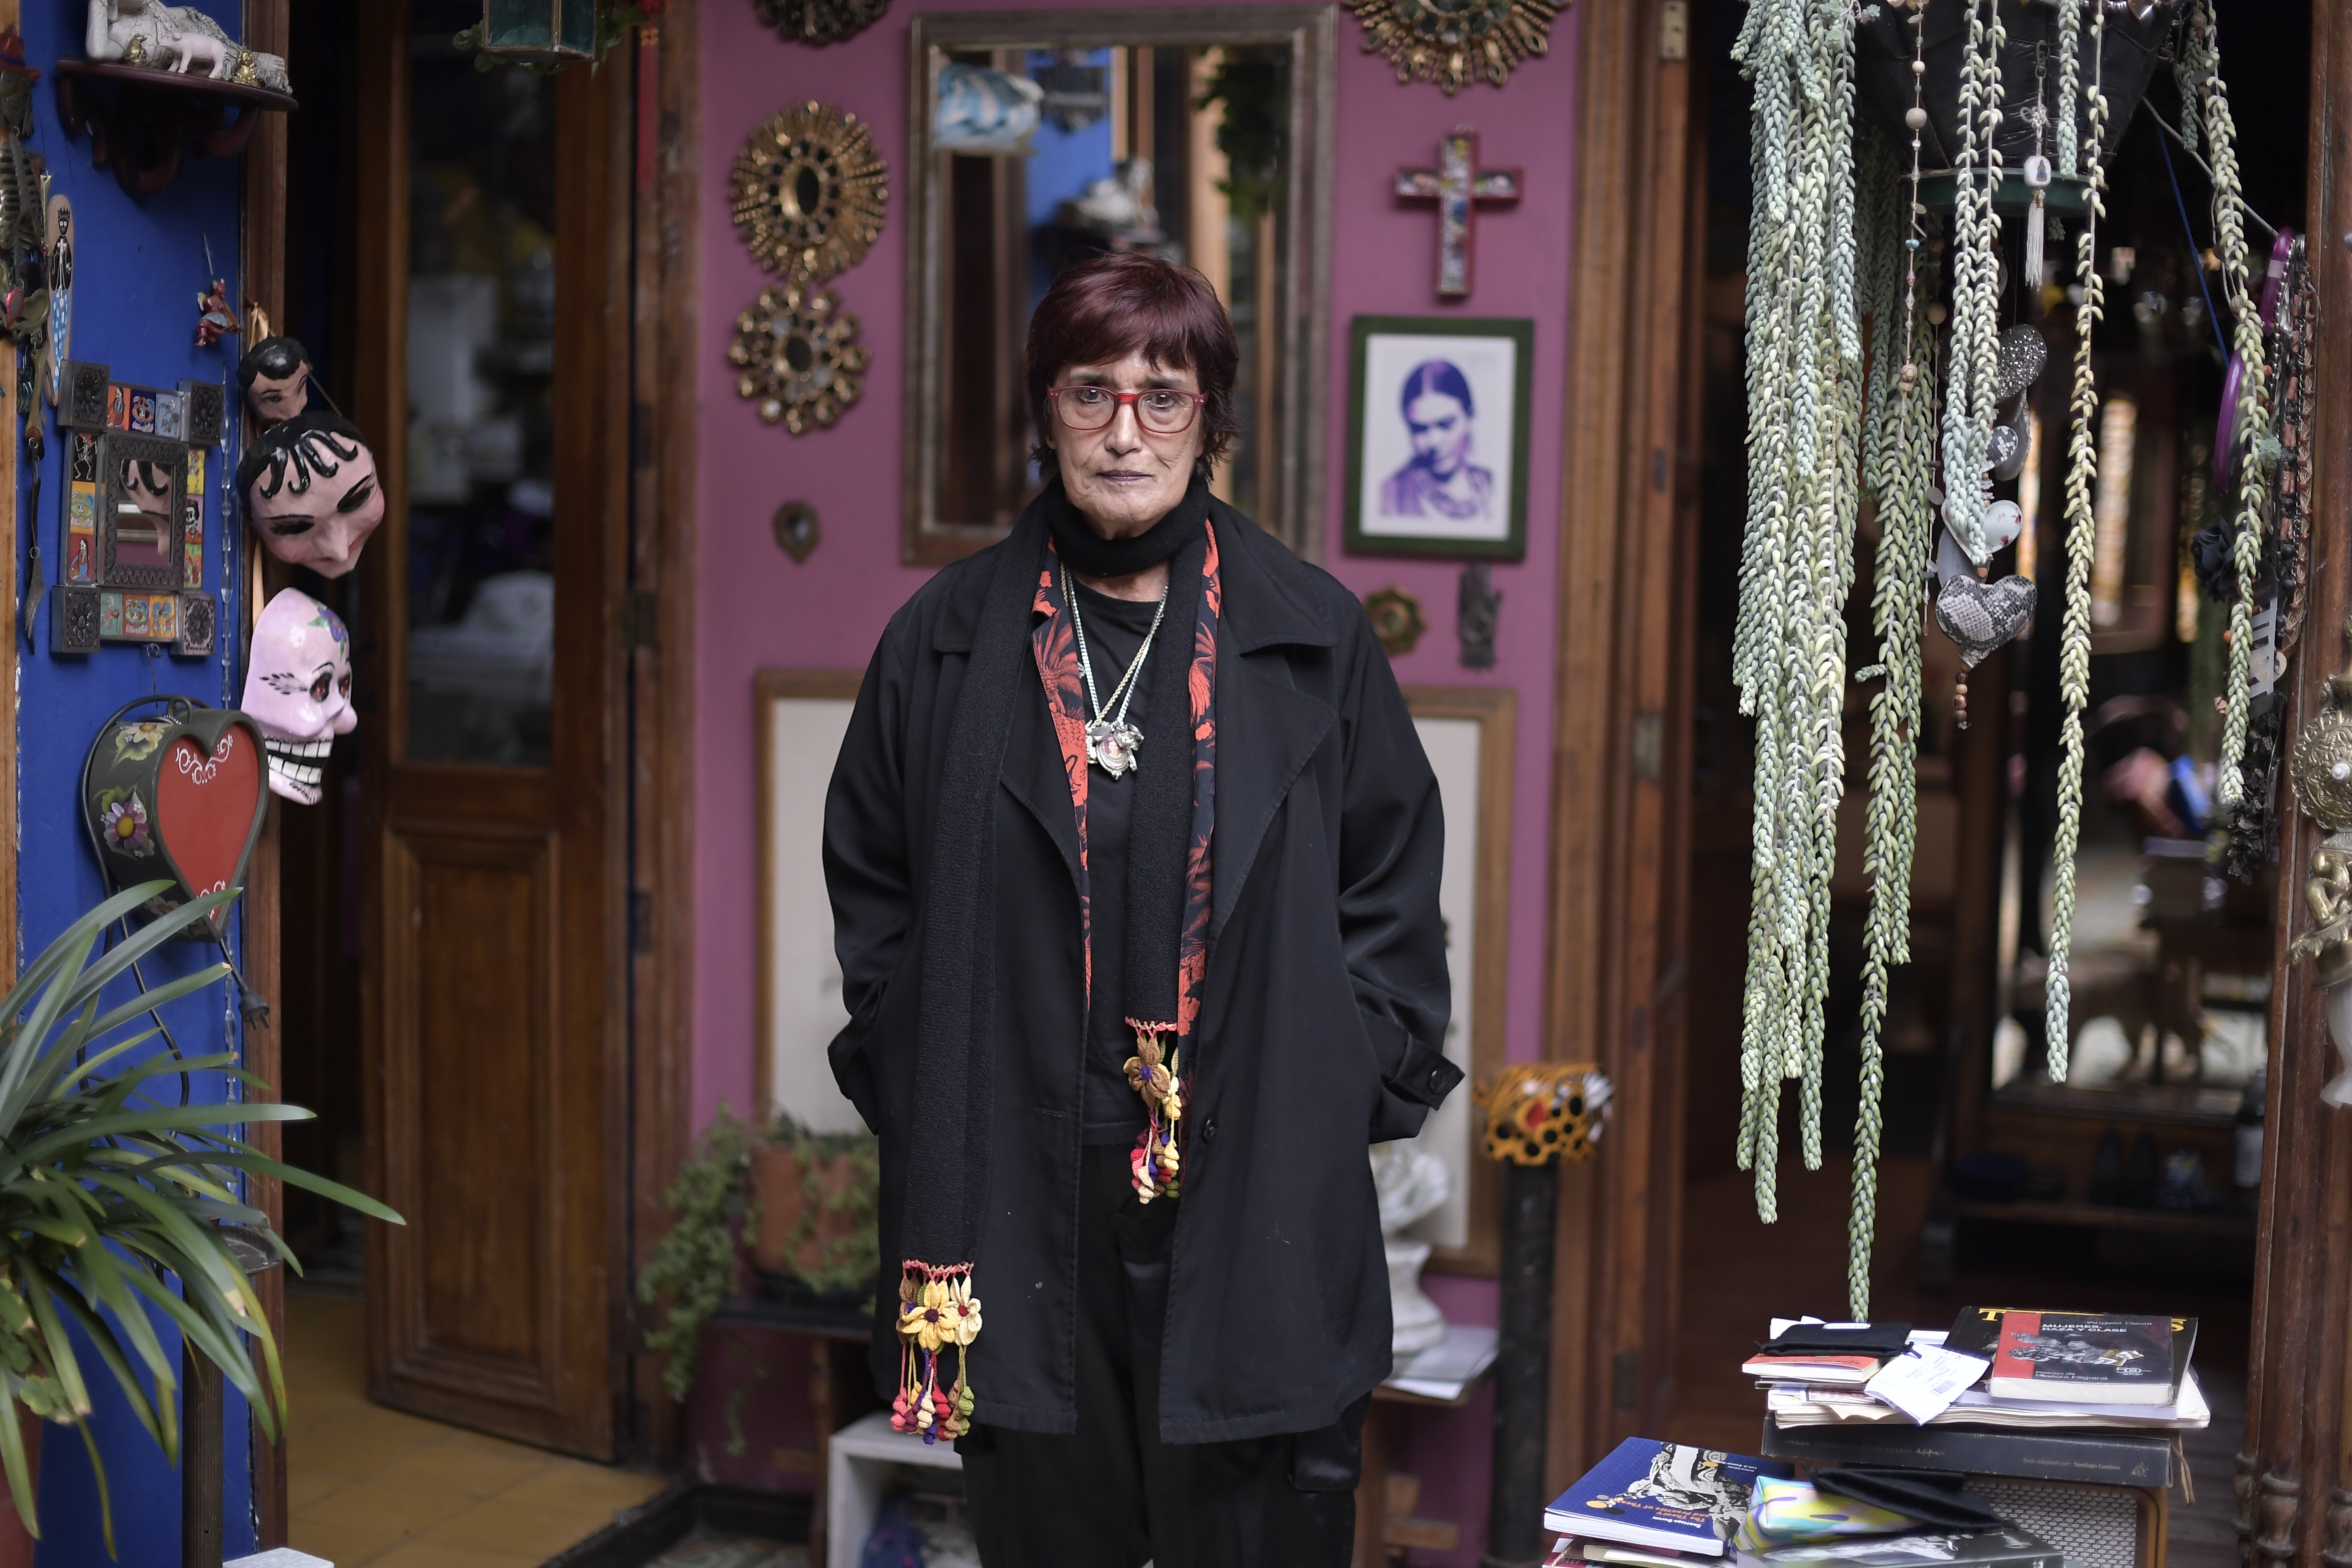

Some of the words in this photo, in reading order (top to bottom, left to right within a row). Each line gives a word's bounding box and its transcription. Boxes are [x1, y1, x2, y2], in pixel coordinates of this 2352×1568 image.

[1655, 1507, 1692, 1516] Practice
[1655, 1511, 1687, 1519] Theory
[1673, 1519, 1701, 1528] Santiago
